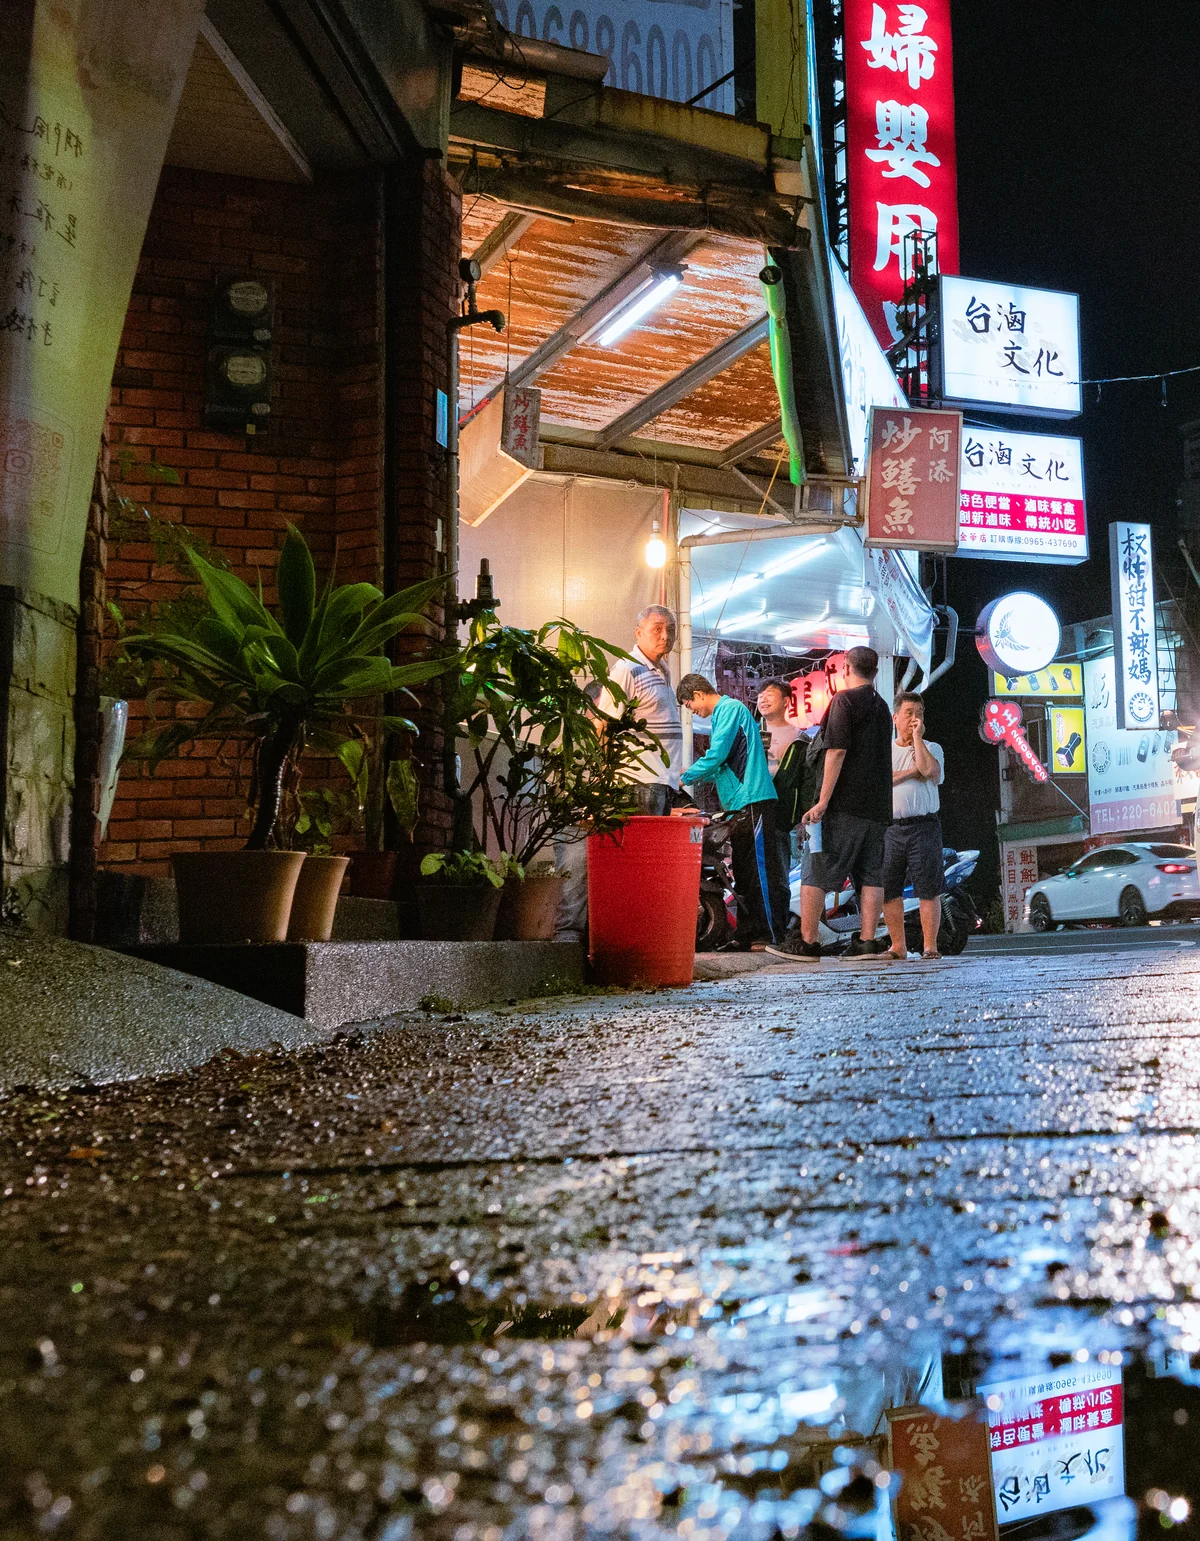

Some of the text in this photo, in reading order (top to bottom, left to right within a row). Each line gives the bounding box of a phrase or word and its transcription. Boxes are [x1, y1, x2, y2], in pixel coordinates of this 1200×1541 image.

[965, 295, 1027, 334] 台滷
[1000, 339, 1064, 377] 文化
[881, 416, 922, 536] 炒鱔魚
[928, 426, 954, 484] 阿添
[964, 437, 1069, 482] 台滷文化
[1011, 729, 1048, 780] 2206402
